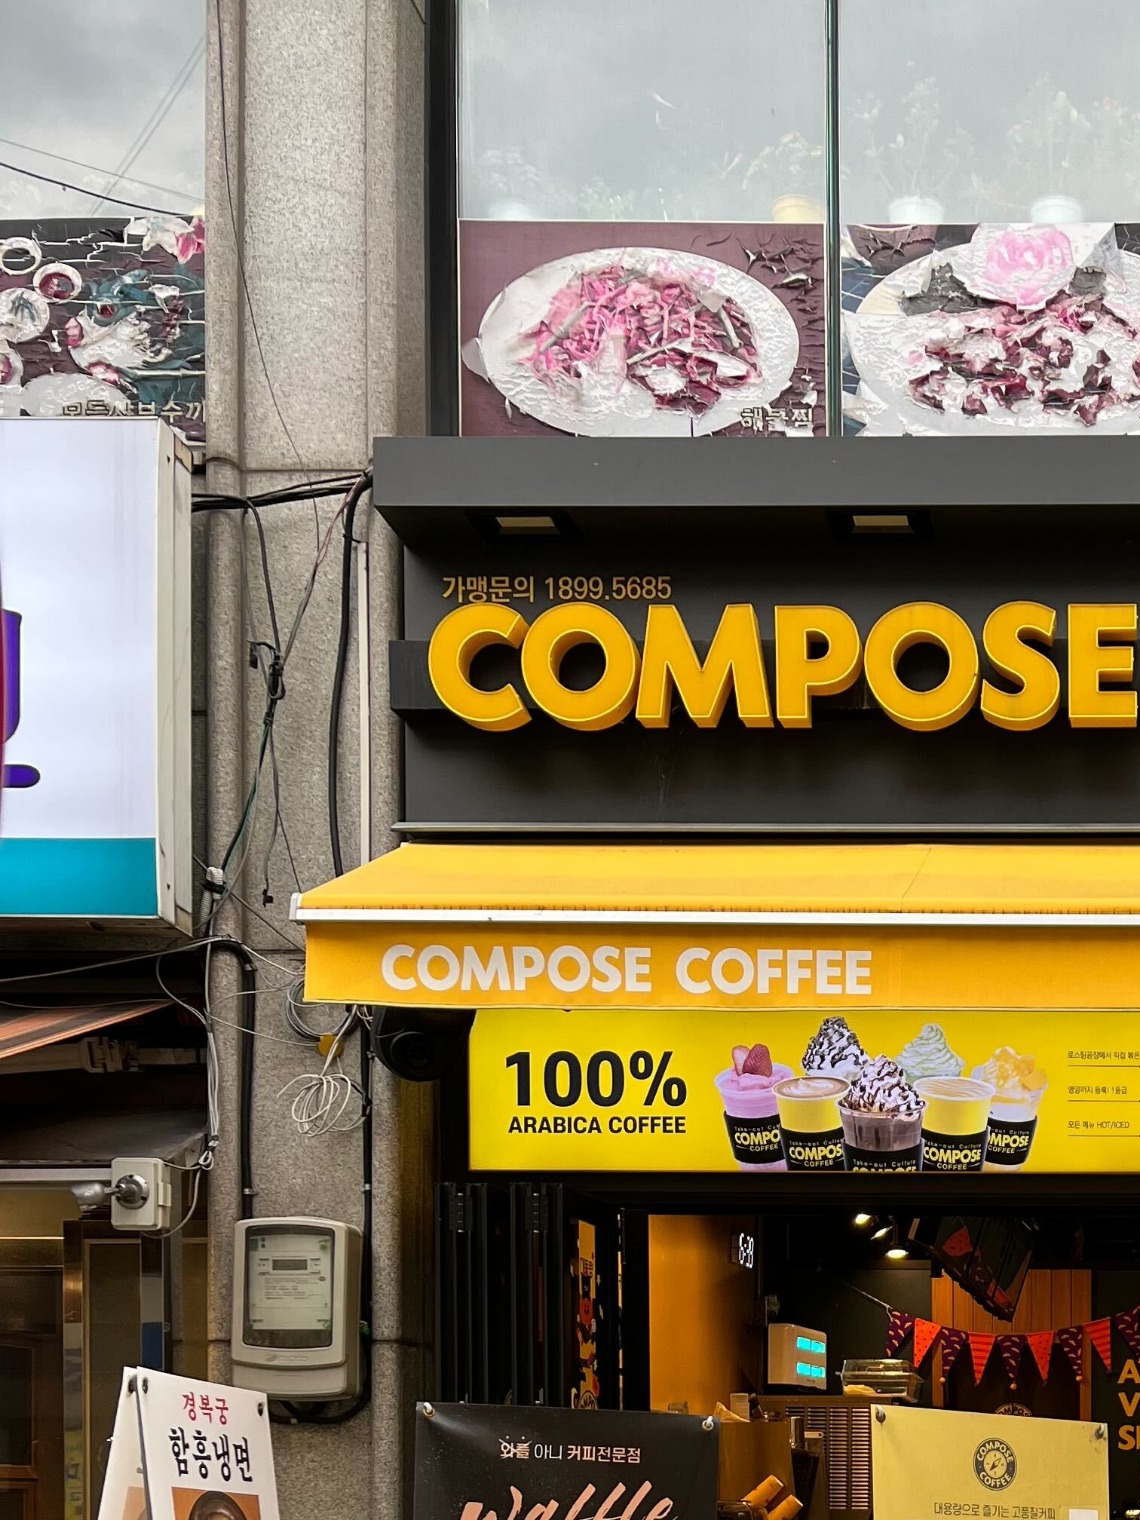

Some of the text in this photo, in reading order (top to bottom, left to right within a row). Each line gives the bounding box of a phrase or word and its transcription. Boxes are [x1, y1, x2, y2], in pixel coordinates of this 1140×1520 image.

[441, 575, 672, 603] 가맹문의 1899.5685
[428, 601, 1138, 731] COMPOSE
[380, 943, 873, 995] COMPOSE COFFEE
[505, 1049, 688, 1108] 100%
[508, 1115, 687, 1134] ARABICA COFFEE
[734, 1129, 781, 1146] COMPO
[988, 1132, 1029, 1147] OMPOSE
[788, 1144, 844, 1160] COMPOS
[181, 1391, 230, 1426] 경복궁
[168, 1426, 254, 1483] 함흥냉면
[533, 1444, 563, 1460] 아니
[567, 1444, 641, 1463] 커피전문점
[976, 1440, 1015, 1464] COMPOSE
[978, 1471, 1013, 1489] COFFEE
[933, 1502, 1056, 1520] 대용량으로 즐기는 고품질커피
